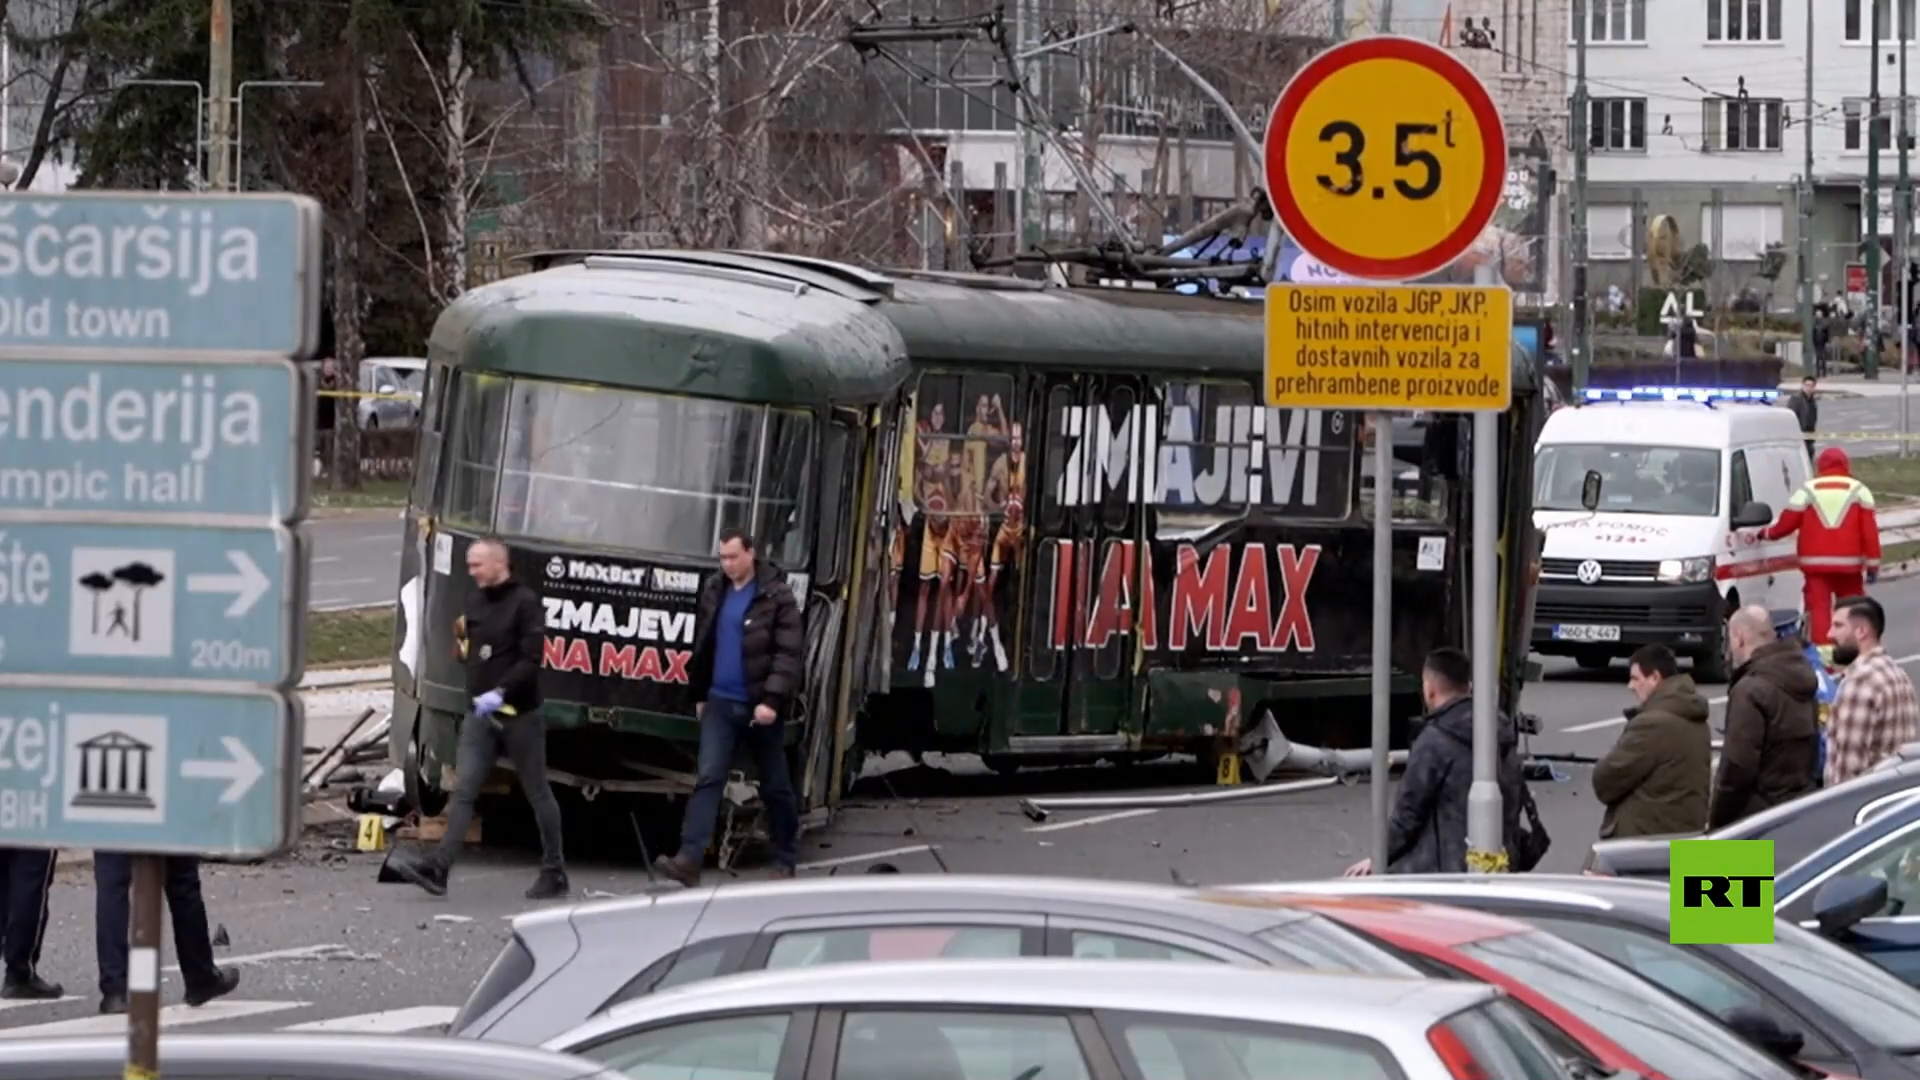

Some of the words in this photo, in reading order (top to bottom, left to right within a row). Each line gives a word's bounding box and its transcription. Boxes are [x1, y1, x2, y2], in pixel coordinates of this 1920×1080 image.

[1289, 289, 1336, 313] Osim
[1343, 290, 1398, 314] vozila
[1404, 291, 1445, 317] JGP,
[1448, 291, 1489, 317] JKP,
[66, 301, 170, 338] town
[1296, 317, 1349, 340] hitnih
[1355, 319, 1470, 347] intervencija
[1475, 325, 1481, 342] i
[1296, 344, 1390, 368] dostavnih
[1397, 346, 1452, 368] vozila
[1458, 351, 1480, 369] za
[1275, 371, 1400, 400] prehrambene
[1406, 374, 1500, 400] proizvode
[124, 463, 204, 502] hall
[1169, 543, 1322, 651] MAX
[542, 597, 697, 643] ZMAJEVI
[190, 641, 270, 668] 200m
[541, 635, 593, 674] NA
[599, 641, 693, 684] MAX
[1222, 758, 1231, 779] 8
[364, 819, 374, 841] 4
